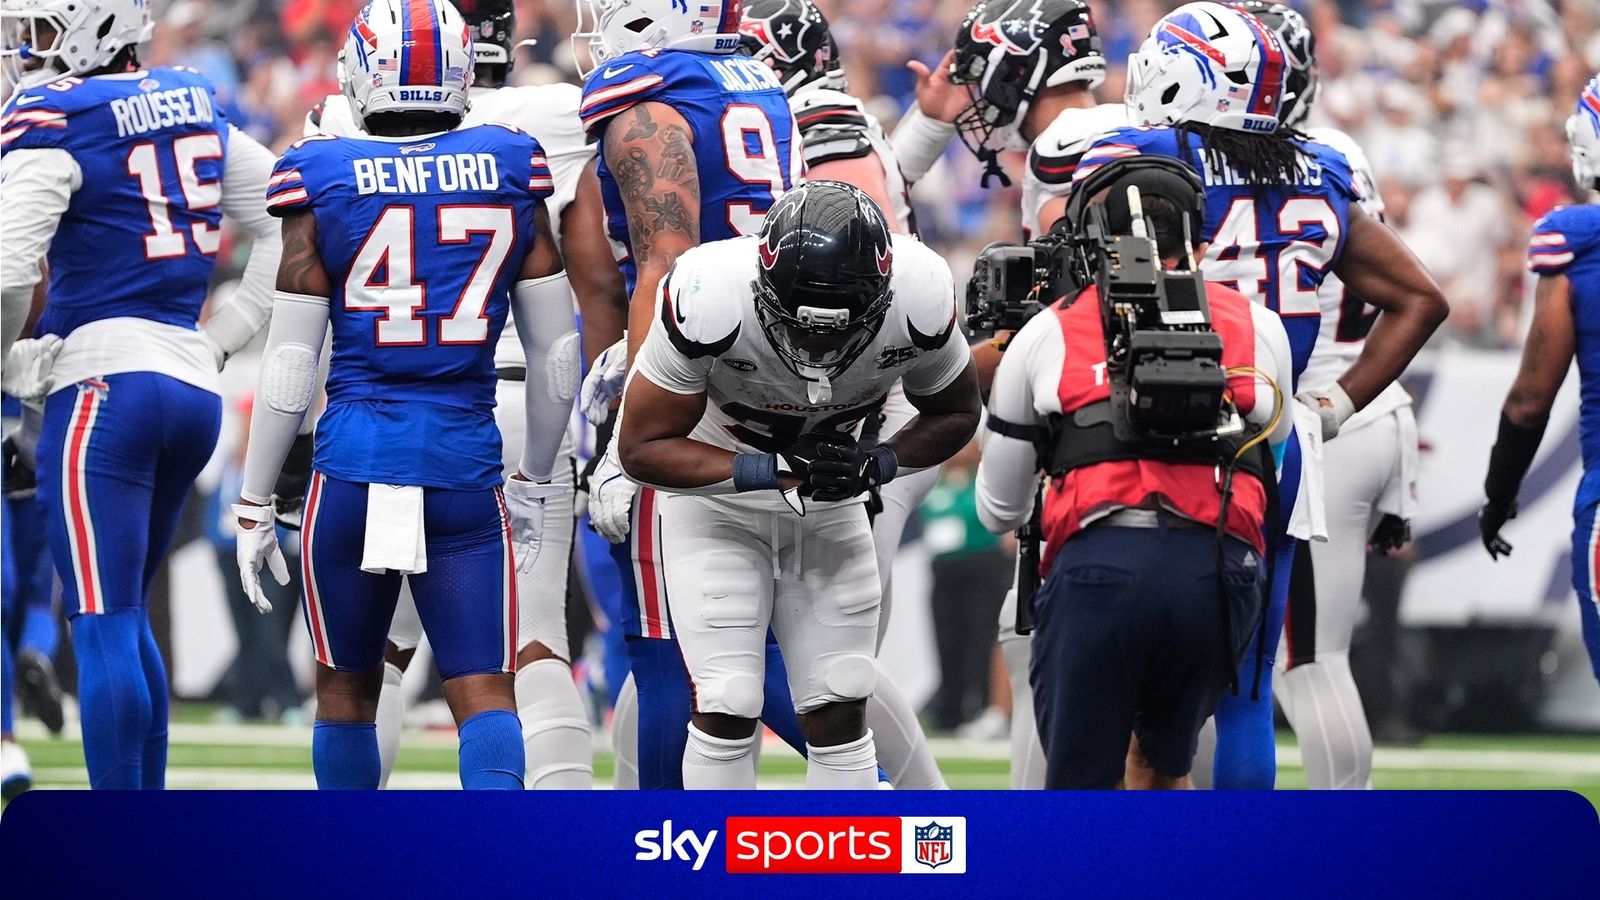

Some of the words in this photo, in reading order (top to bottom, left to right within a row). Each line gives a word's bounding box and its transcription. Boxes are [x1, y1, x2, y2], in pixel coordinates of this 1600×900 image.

[714, 39, 739, 49] BILL
[110, 86, 214, 137] ROUSSEAU
[400, 90, 442, 101] BILLS
[1242, 118, 1276, 132] BILLS
[353, 153, 499, 195] BENFORD
[127, 131, 224, 260] 15
[1197, 195, 1340, 318] 42
[344, 203, 516, 347] 47
[879, 347, 918, 370] 25
[766, 401, 861, 413] HOUSTON
